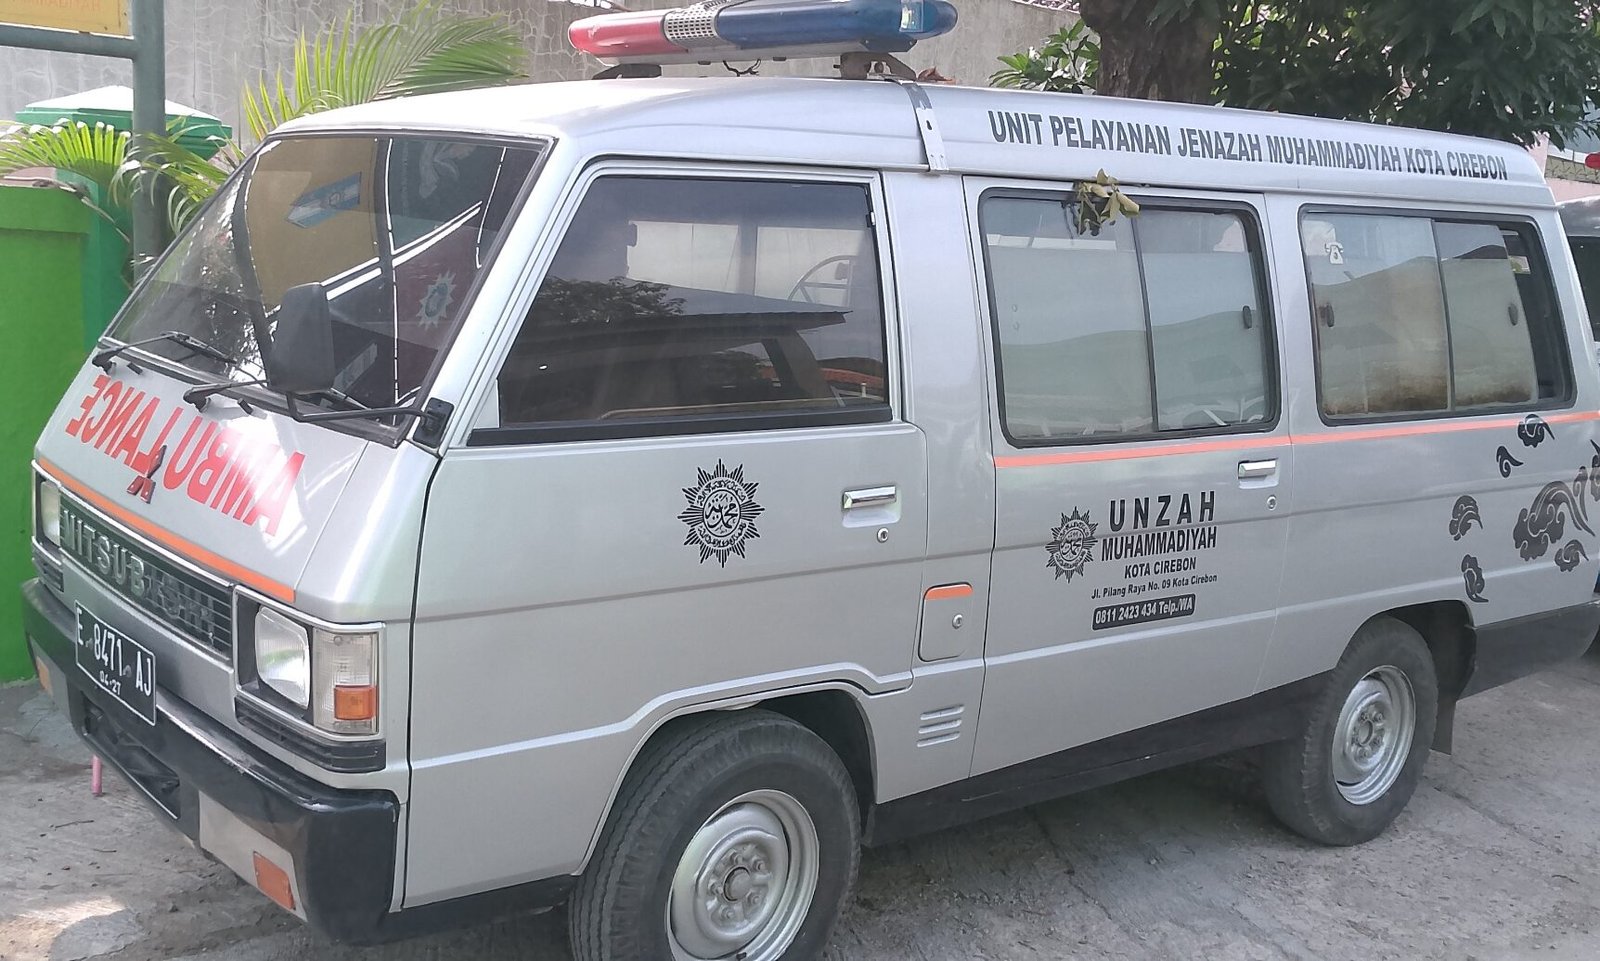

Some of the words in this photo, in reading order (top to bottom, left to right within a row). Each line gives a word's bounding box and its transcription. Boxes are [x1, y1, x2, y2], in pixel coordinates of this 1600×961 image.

[988, 110, 1043, 145] UNIT
[1049, 115, 1171, 155] PELAYANAN
[1177, 127, 1263, 163] JENAZAH
[1266, 135, 1403, 173] MUHAMMADIYAH
[1404, 147, 1446, 176] KOTA
[1447, 151, 1508, 180] CIREBON
[1109, 490, 1215, 532] UNZAH
[1101, 526, 1217, 562] MUHAMMADIYAH
[1103, 585, 1126, 598] Pilang
[1128, 583, 1146, 596] Raya
[1148, 581, 1160, 591] No.
[1162, 579, 1171, 589] 09
[1173, 577, 1189, 588] Kota
[1191, 573, 1218, 585] Cirebon
[1124, 562, 1150, 579] KOTA
[1153, 556, 1197, 575] CIREBON
[1095, 608, 1116, 624] 0811
[1118, 604, 1140, 620] 2423
[1141, 602, 1157, 616] 434
[77, 607, 84, 645] E
[94, 623, 122, 676] 8471
[136, 651, 151, 696] AJ
